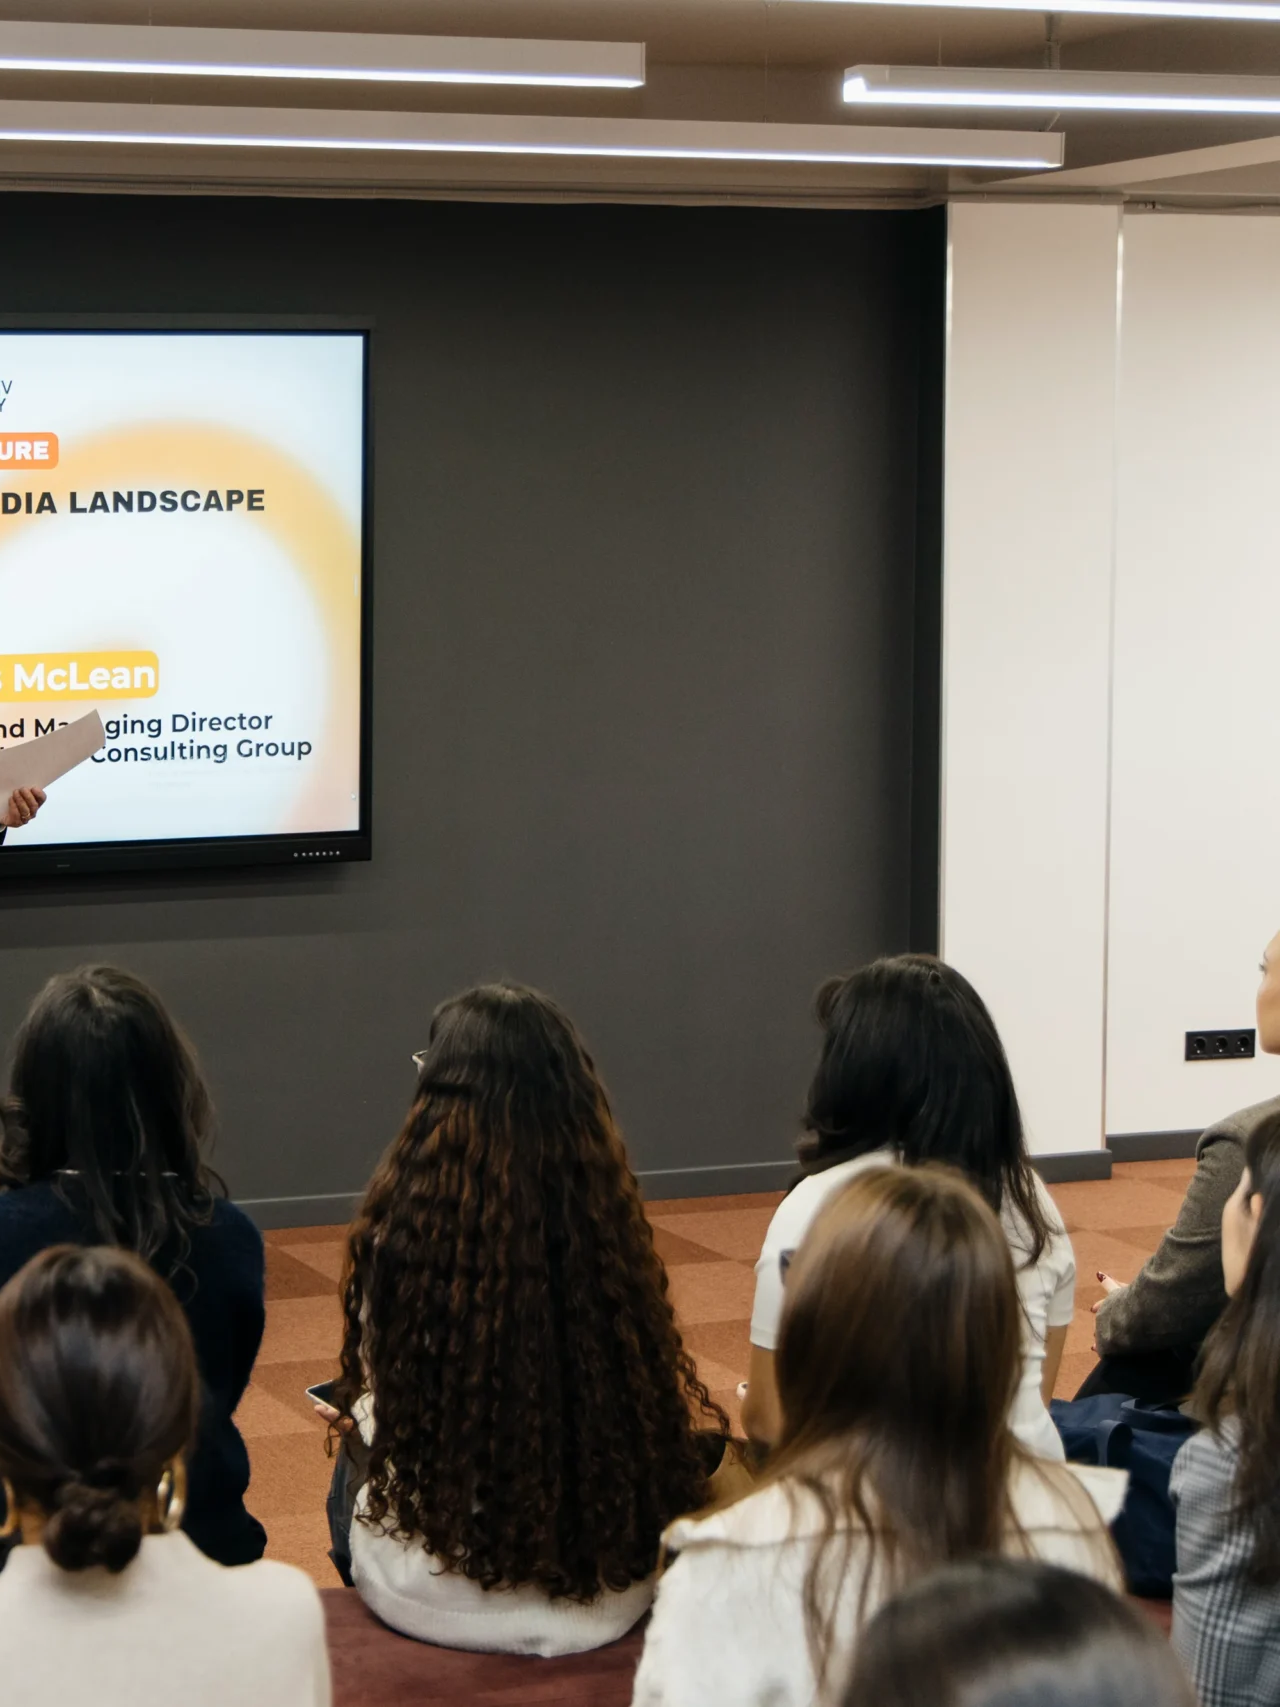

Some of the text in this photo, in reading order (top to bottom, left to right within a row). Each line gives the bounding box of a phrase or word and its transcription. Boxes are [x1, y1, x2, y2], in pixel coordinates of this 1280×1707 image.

[69, 489, 265, 513] LANDSCAPE
[13, 661, 155, 692] McLean
[34, 713, 162, 740] Mging
[171, 711, 273, 733] Director
[236, 739, 312, 762] Group
